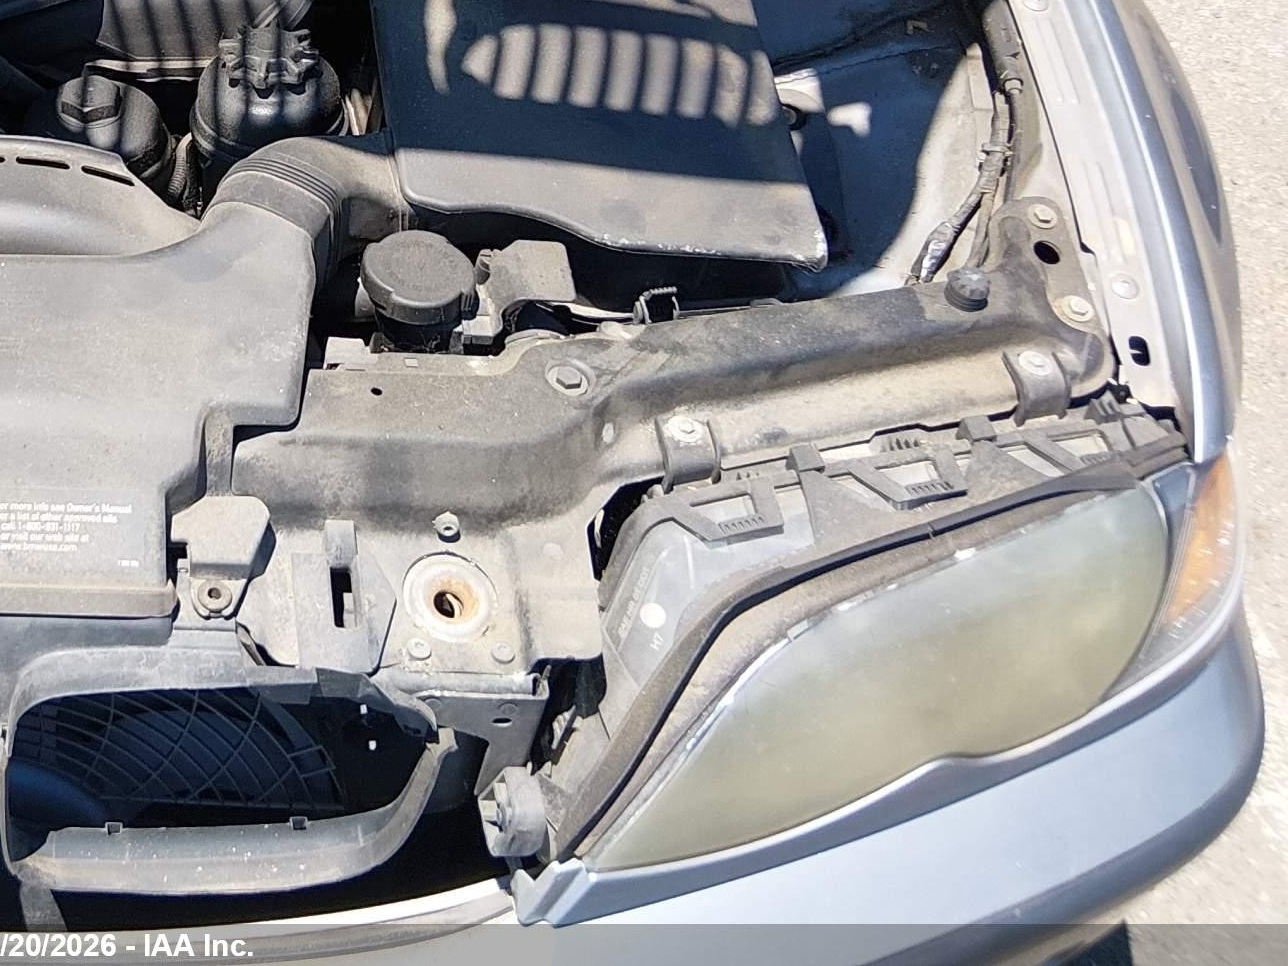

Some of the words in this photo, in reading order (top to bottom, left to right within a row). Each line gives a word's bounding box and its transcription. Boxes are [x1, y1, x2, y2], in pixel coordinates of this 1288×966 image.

[10, 503, 32, 511] more
[66, 503, 100, 513] Owner's
[101, 503, 132, 514] Manual
[17, 512, 30, 522] list
[40, 513, 62, 523] other
[63, 513, 102, 524] approved
[18, 521, 80, 532] 1-800-831-1117
[30, 534, 43, 542] our
[44, 533, 63, 542] web
[80, 534, 90, 543] at
[0, 542, 78, 553] www.bmwusa.com
[649, 631, 664, 651] H7
